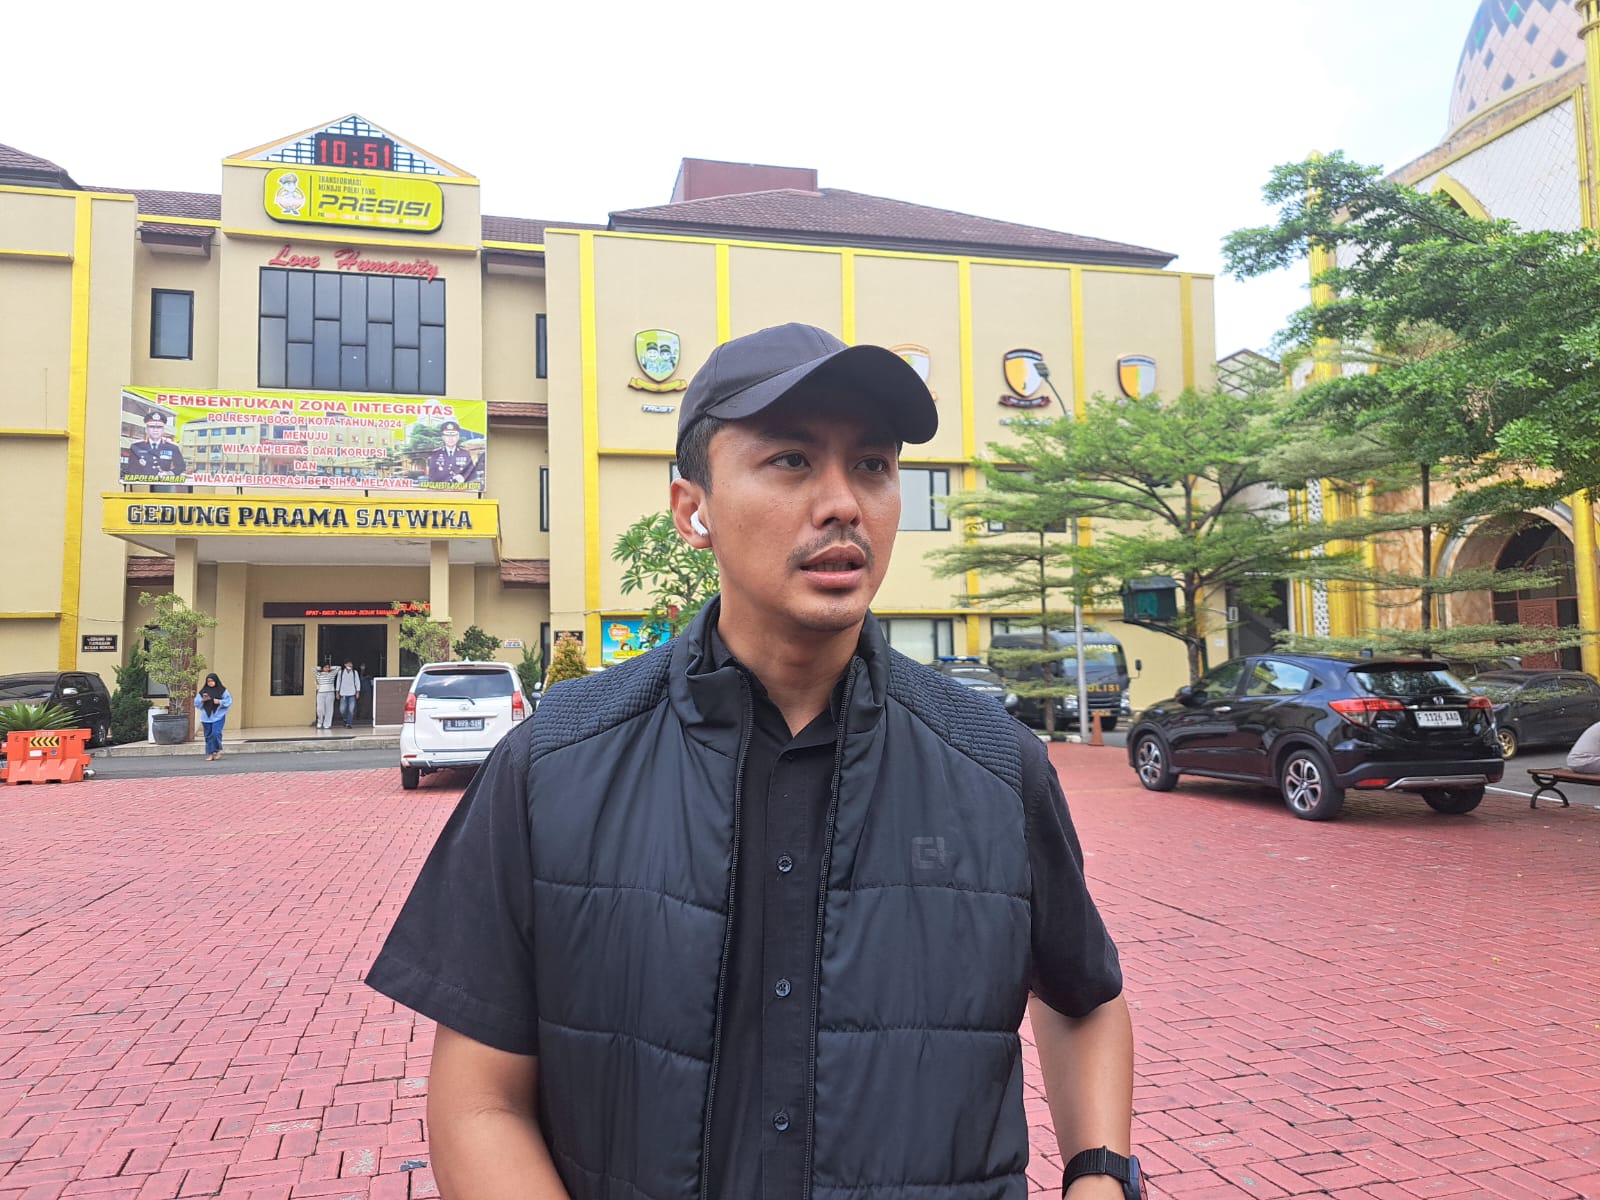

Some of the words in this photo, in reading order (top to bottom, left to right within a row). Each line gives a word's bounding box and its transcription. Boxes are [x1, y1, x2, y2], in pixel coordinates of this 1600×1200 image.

[320, 139, 391, 169] 10:51
[318, 194, 432, 217] PRESISI
[268, 244, 321, 269] Love
[334, 248, 439, 283] Humanity
[156, 394, 294, 410] PEMBENTUKAN
[300, 400, 347, 413] ZONA
[353, 402, 453, 416] INTEGRITAS
[208, 413, 263, 424] POLRESTA
[267, 415, 305, 425] BOGOR
[308, 416, 335, 426] KOTA
[340, 417, 375, 427] TAHUN
[378, 419, 402, 428] 2024
[283, 431, 329, 441] MENUJU
[223, 444, 271, 454] WILAYAH
[274, 445, 309, 455] BEBAS
[313, 446, 337, 456] DARI
[340, 448, 387, 457] KORUPSI
[295, 461, 317, 470] DAN
[124, 474, 159, 483] KAPOLDA
[193, 474, 243, 484] WILAYAH
[246, 475, 304, 485] BIROKRASI
[308, 476, 346, 486] BERSIH
[350, 477, 357, 486] &
[361, 478, 413, 488] MELAYANI
[127, 504, 230, 526] GEDUNG
[238, 506, 349, 528] PARAMA
[356, 508, 473, 529] SATWIKA
[1087, 684, 1120, 693] OLISI
